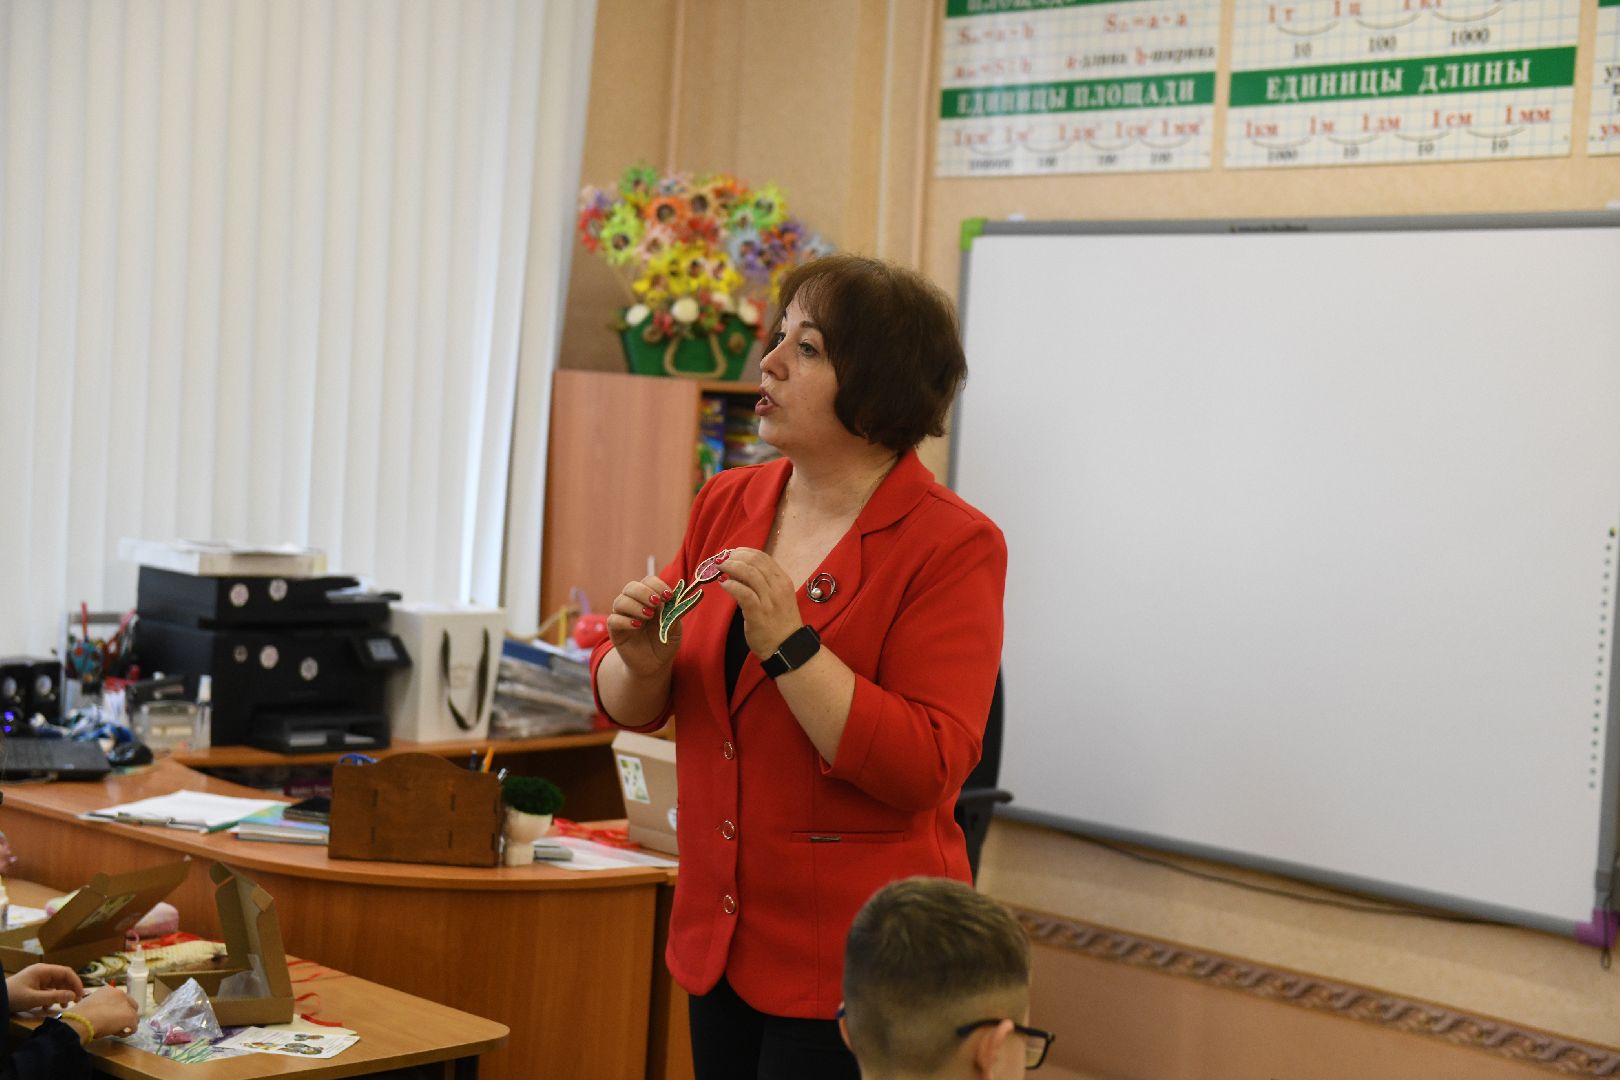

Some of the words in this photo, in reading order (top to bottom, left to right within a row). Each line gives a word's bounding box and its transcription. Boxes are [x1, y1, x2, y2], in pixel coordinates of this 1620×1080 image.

[1265, 67, 1405, 103] ЕДИНИЦЫ
[1418, 57, 1531, 93] ДЛИНЫ
[956, 86, 1068, 116] ЕДИНИЦЫ
[1072, 79, 1195, 109] ПЛОЩАДИ
[1519, 108, 1551, 124] мм
[1491, 138, 1510, 153] 10
